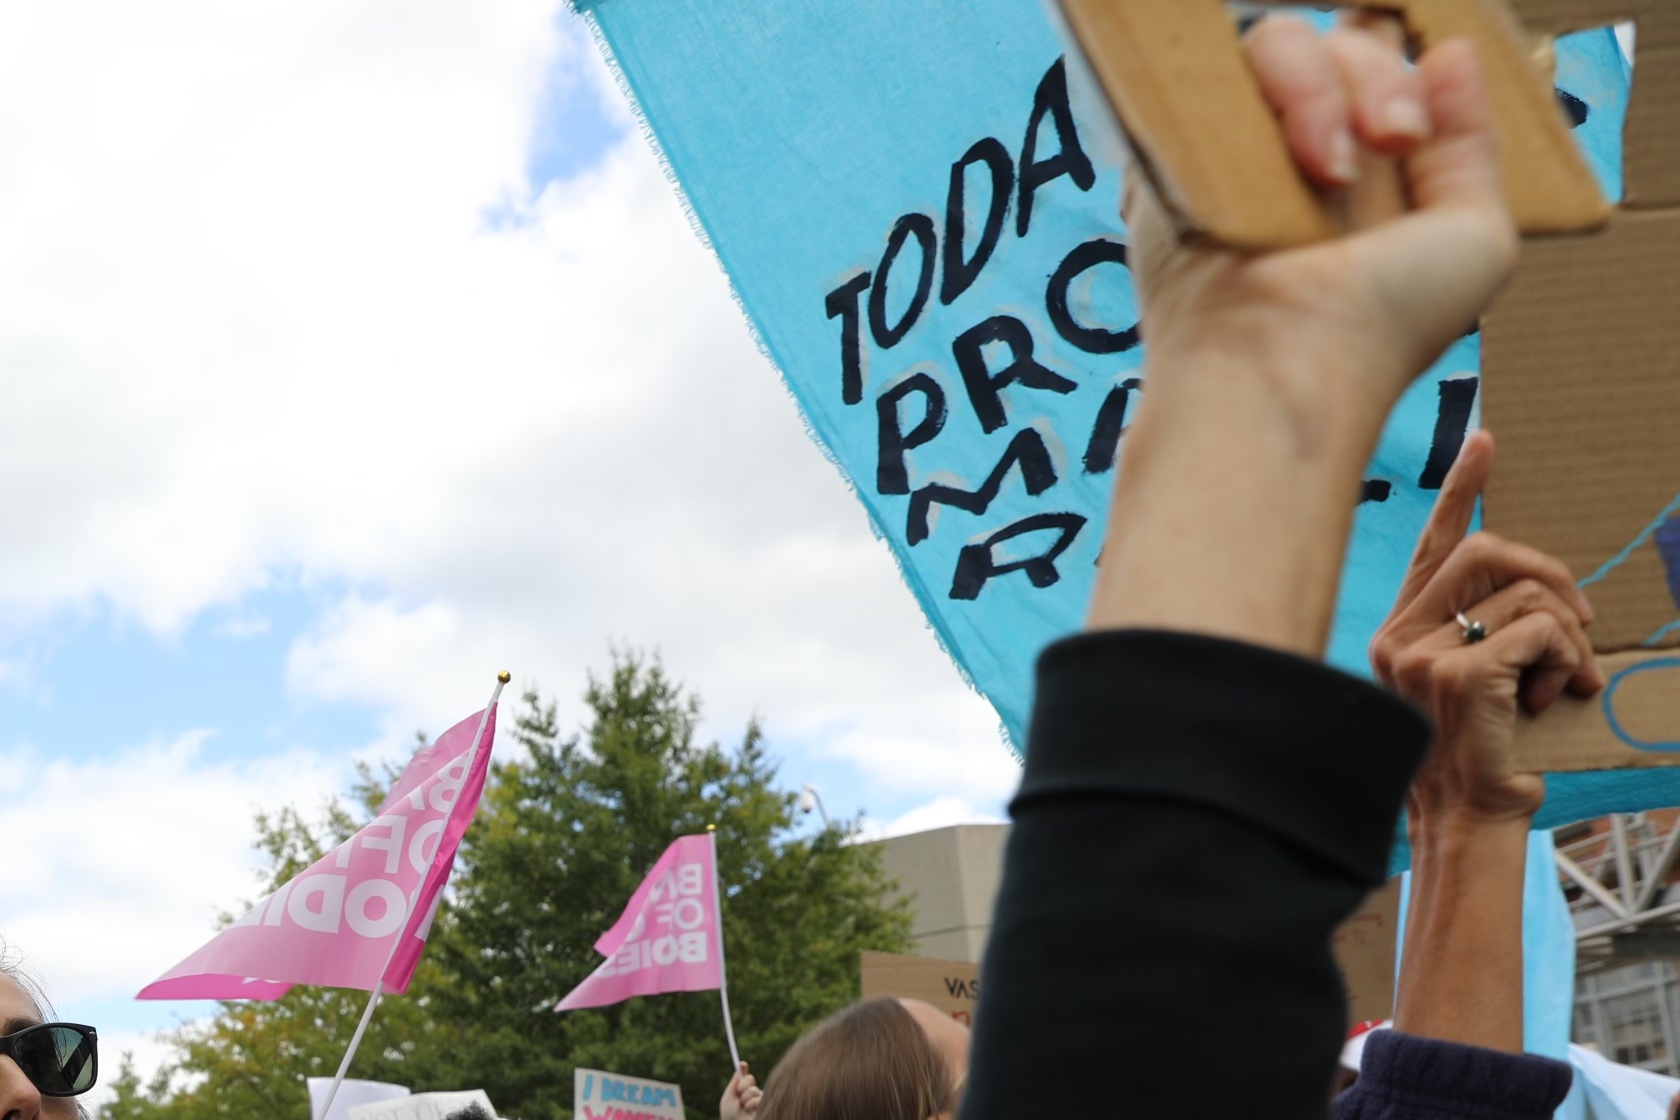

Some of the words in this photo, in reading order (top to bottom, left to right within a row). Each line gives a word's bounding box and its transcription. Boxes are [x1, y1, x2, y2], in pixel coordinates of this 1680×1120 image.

[825, 54, 1095, 404] TODA
[583, 1074, 593, 1101] I
[601, 1078, 677, 1108] DREAM
